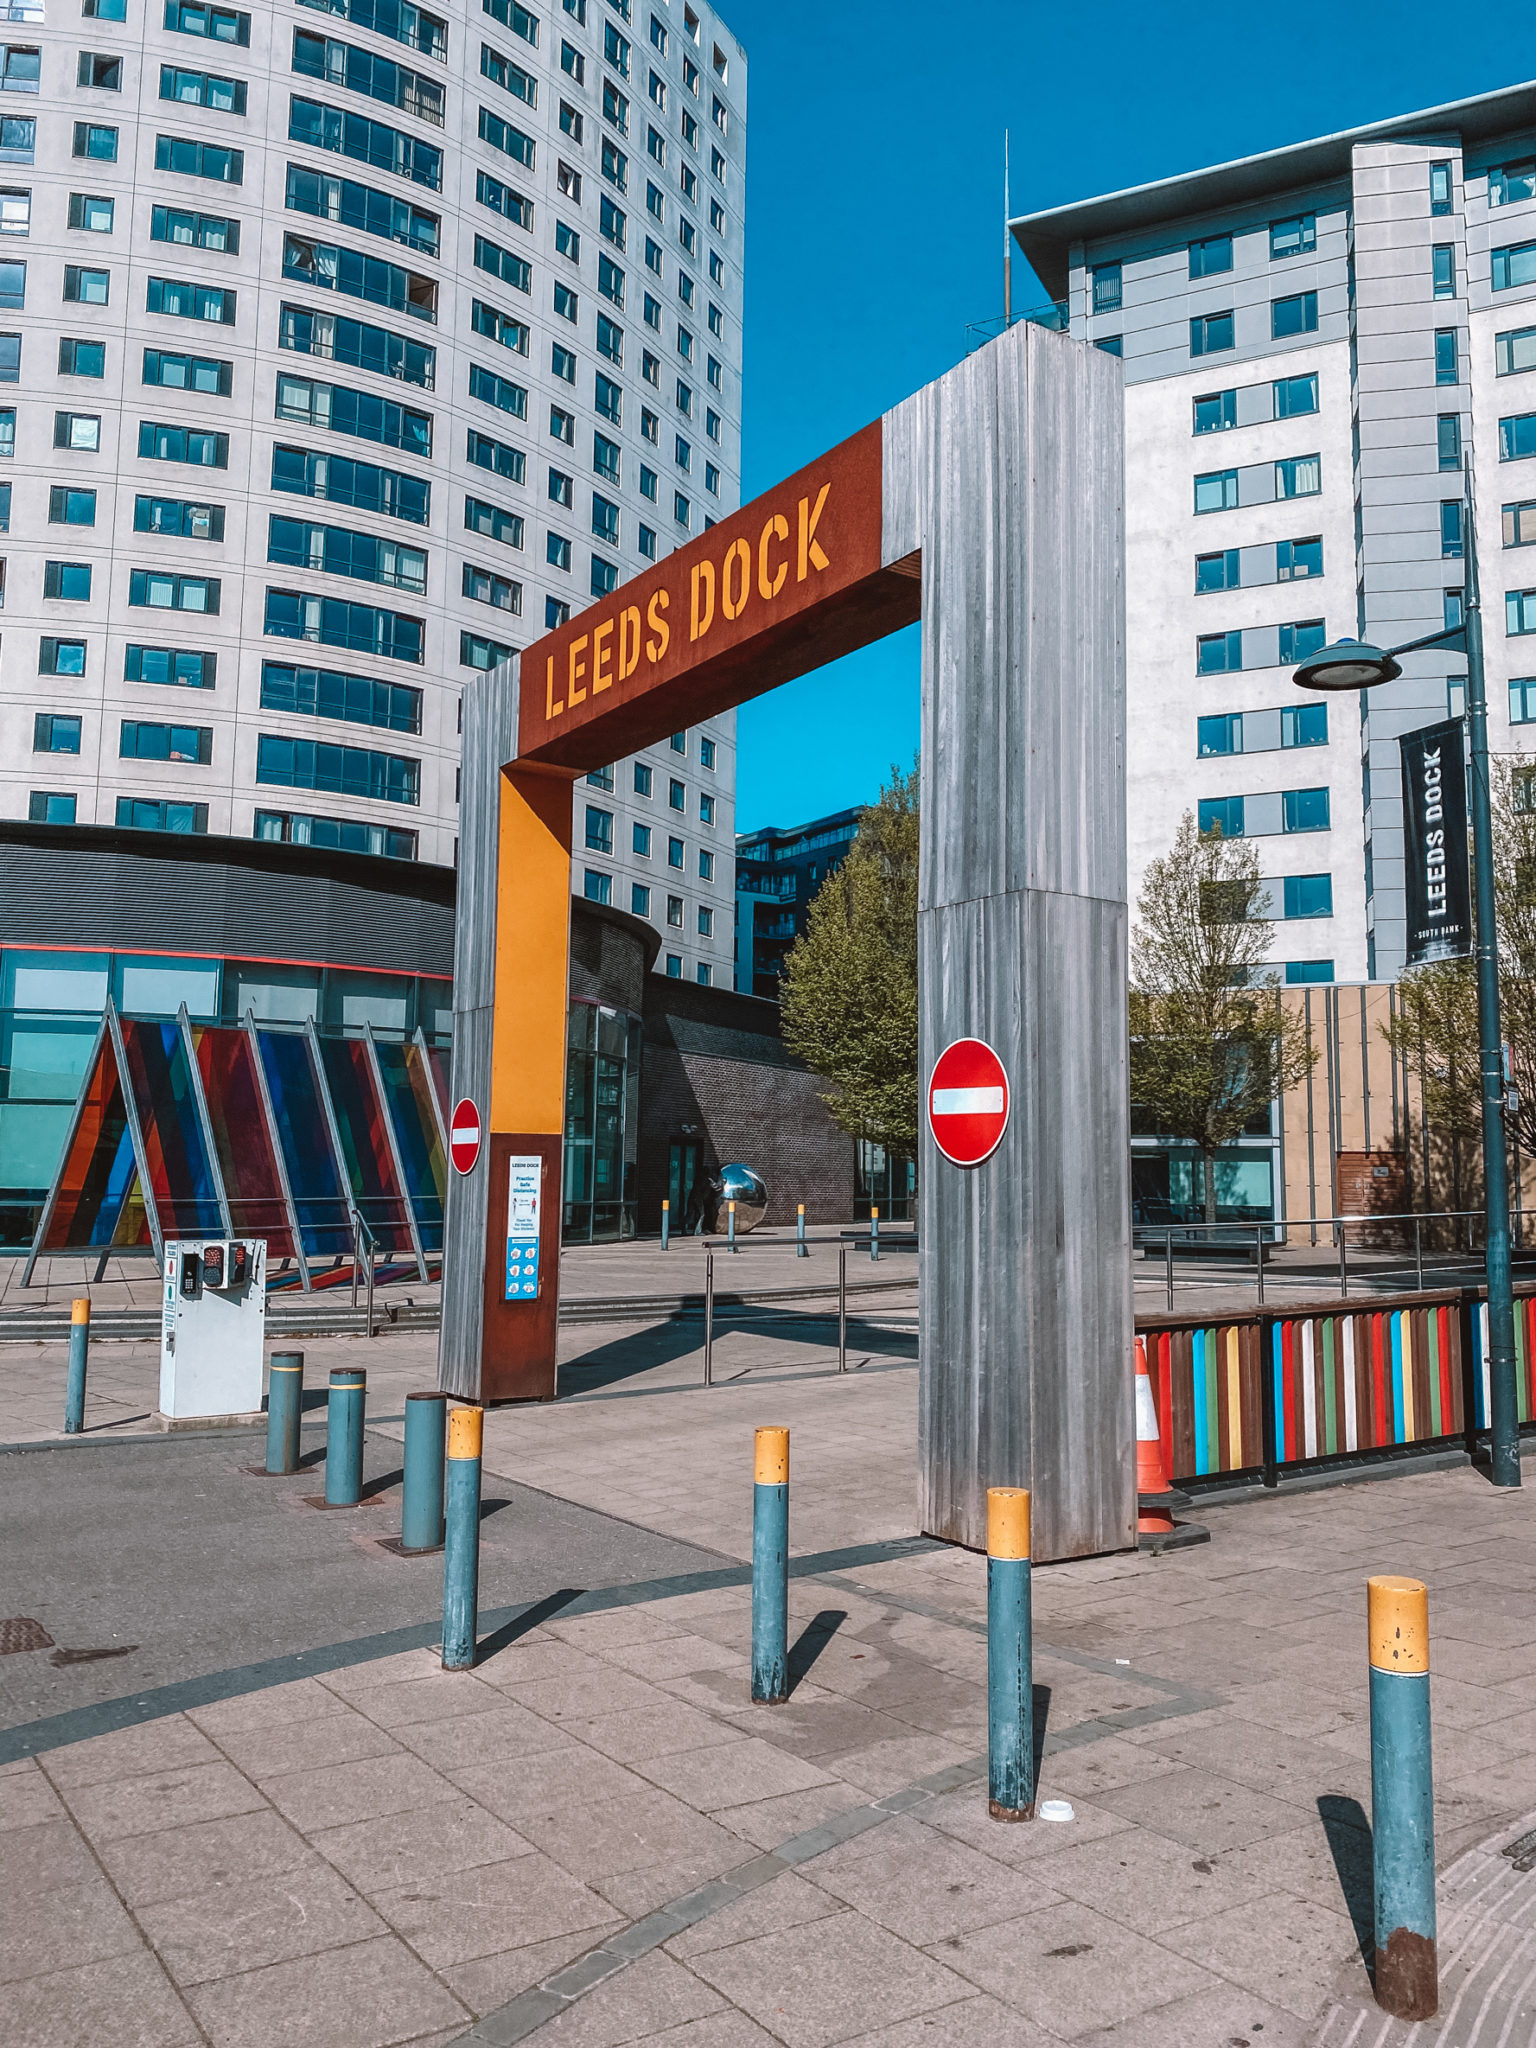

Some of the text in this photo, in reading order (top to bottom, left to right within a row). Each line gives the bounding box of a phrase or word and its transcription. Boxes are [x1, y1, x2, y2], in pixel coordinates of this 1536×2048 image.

[545, 481, 832, 721] LEEDS DOCK
[1424, 747, 1446, 917] LEEDS DOCK
